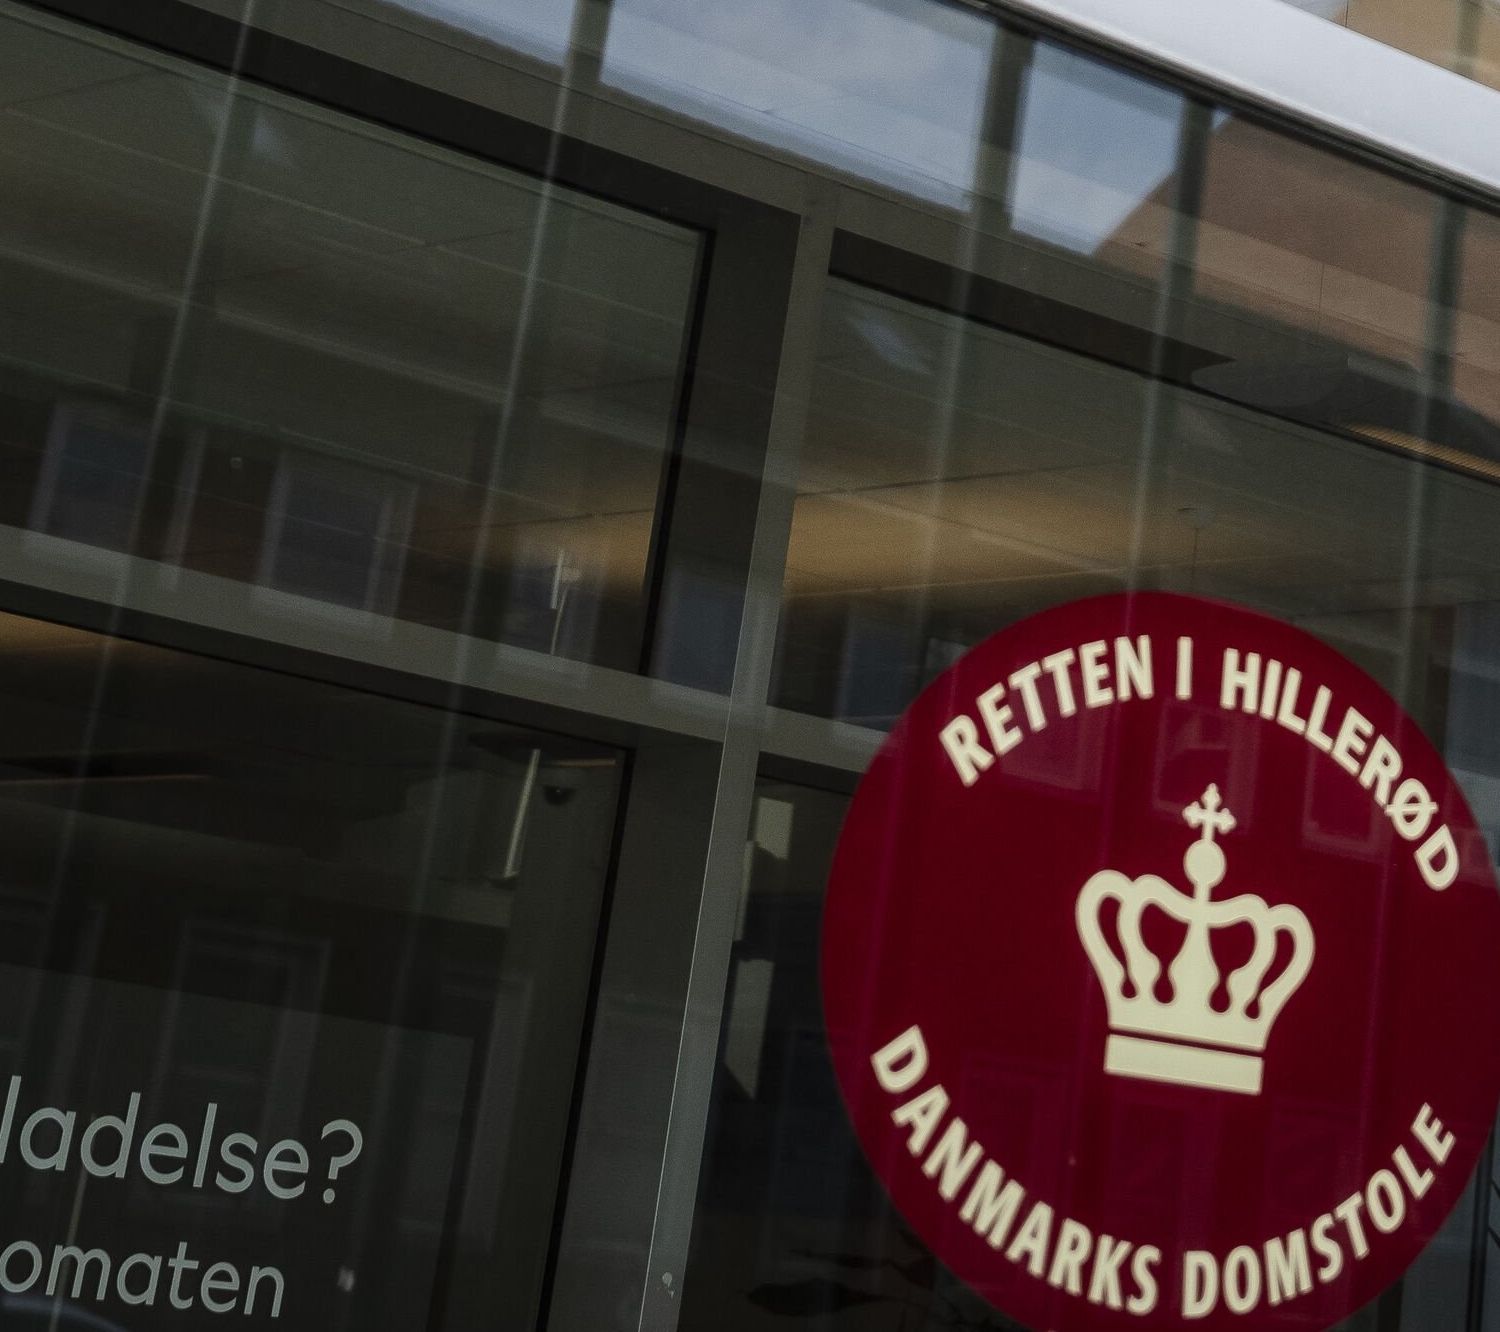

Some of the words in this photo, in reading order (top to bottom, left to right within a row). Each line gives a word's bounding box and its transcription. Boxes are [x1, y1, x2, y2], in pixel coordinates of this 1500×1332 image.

[938, 634, 1154, 787] RETTEN
[1175, 636, 1193, 700] I
[1220, 647, 1461, 892] HILLERØD
[871, 1024, 1162, 1315] DANMARKS
[1181, 1102, 1456, 1319] DOMSTOLE
